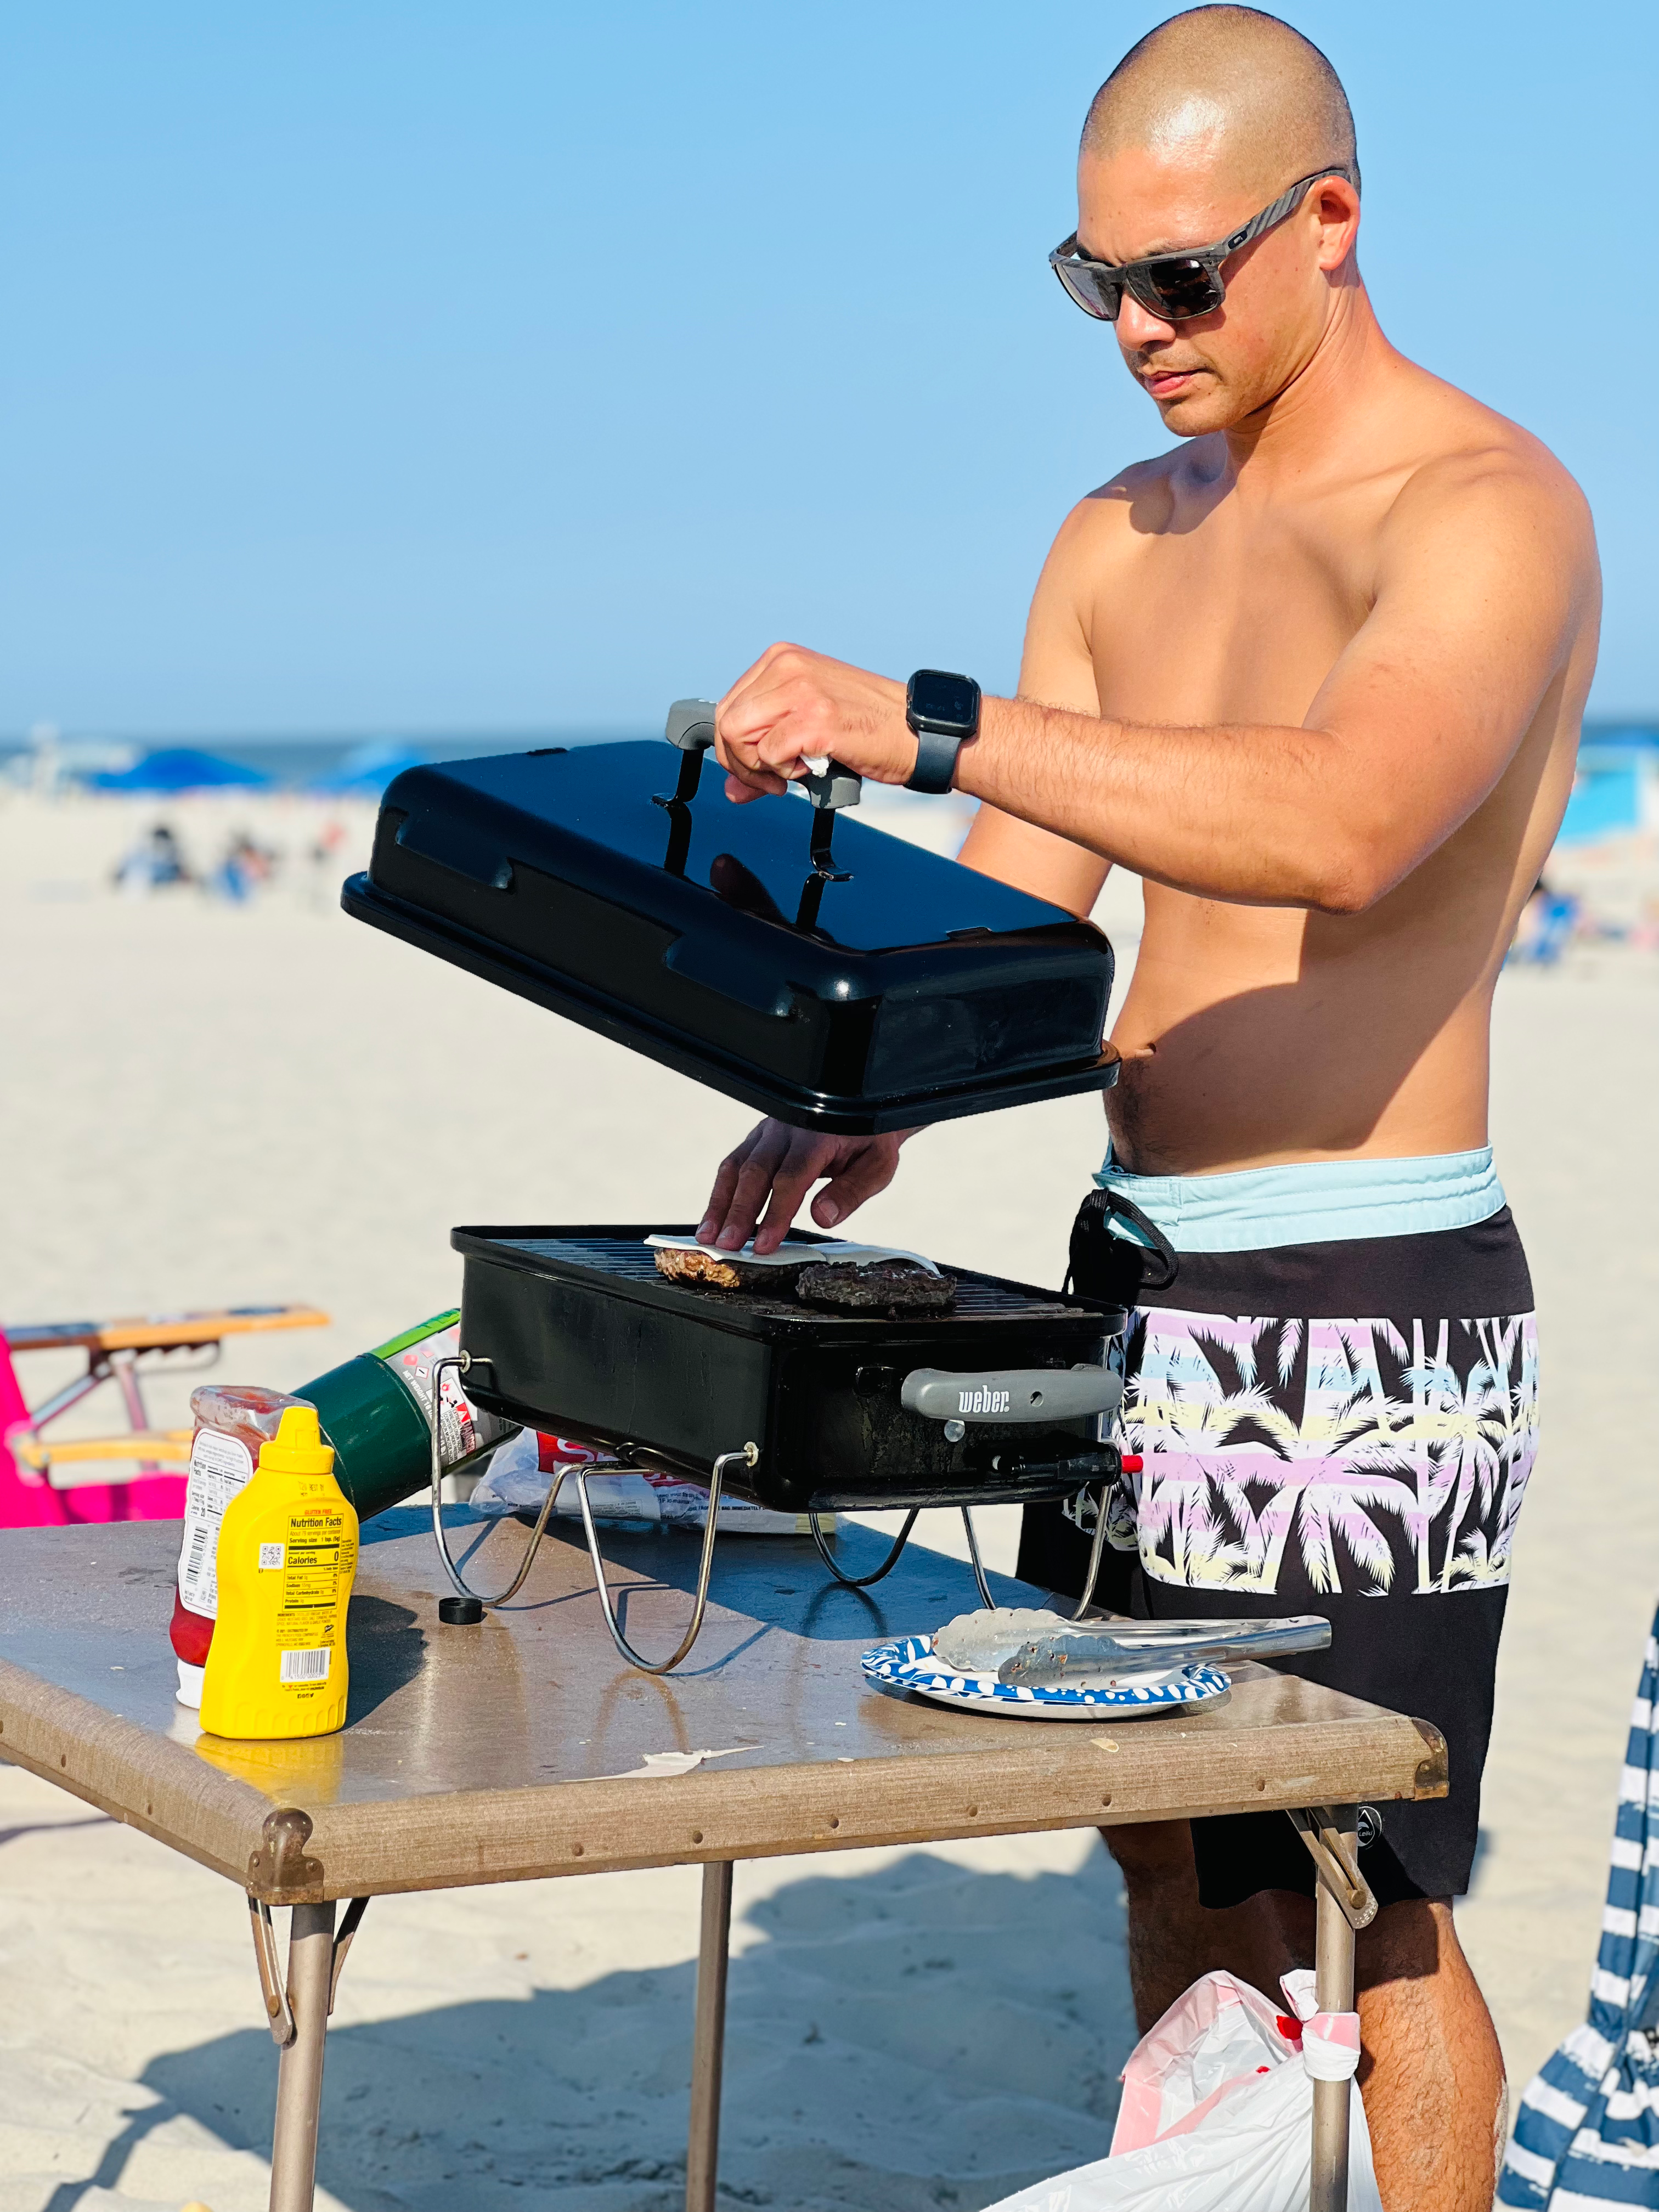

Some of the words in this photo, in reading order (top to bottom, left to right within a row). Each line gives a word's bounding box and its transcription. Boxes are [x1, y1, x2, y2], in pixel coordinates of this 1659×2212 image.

[403, 1370, 414, 1381] NET
[411, 1379, 427, 1401] WEIGHT
[958, 1385, 1009, 1413] weber
[462, 1419, 476, 1453] DANGER
[291, 1518, 323, 1527] Nutrition
[325, 1516, 342, 1526] Facts
[288, 1556, 317, 1565] Calories
[334, 1551, 339, 1562] 0
